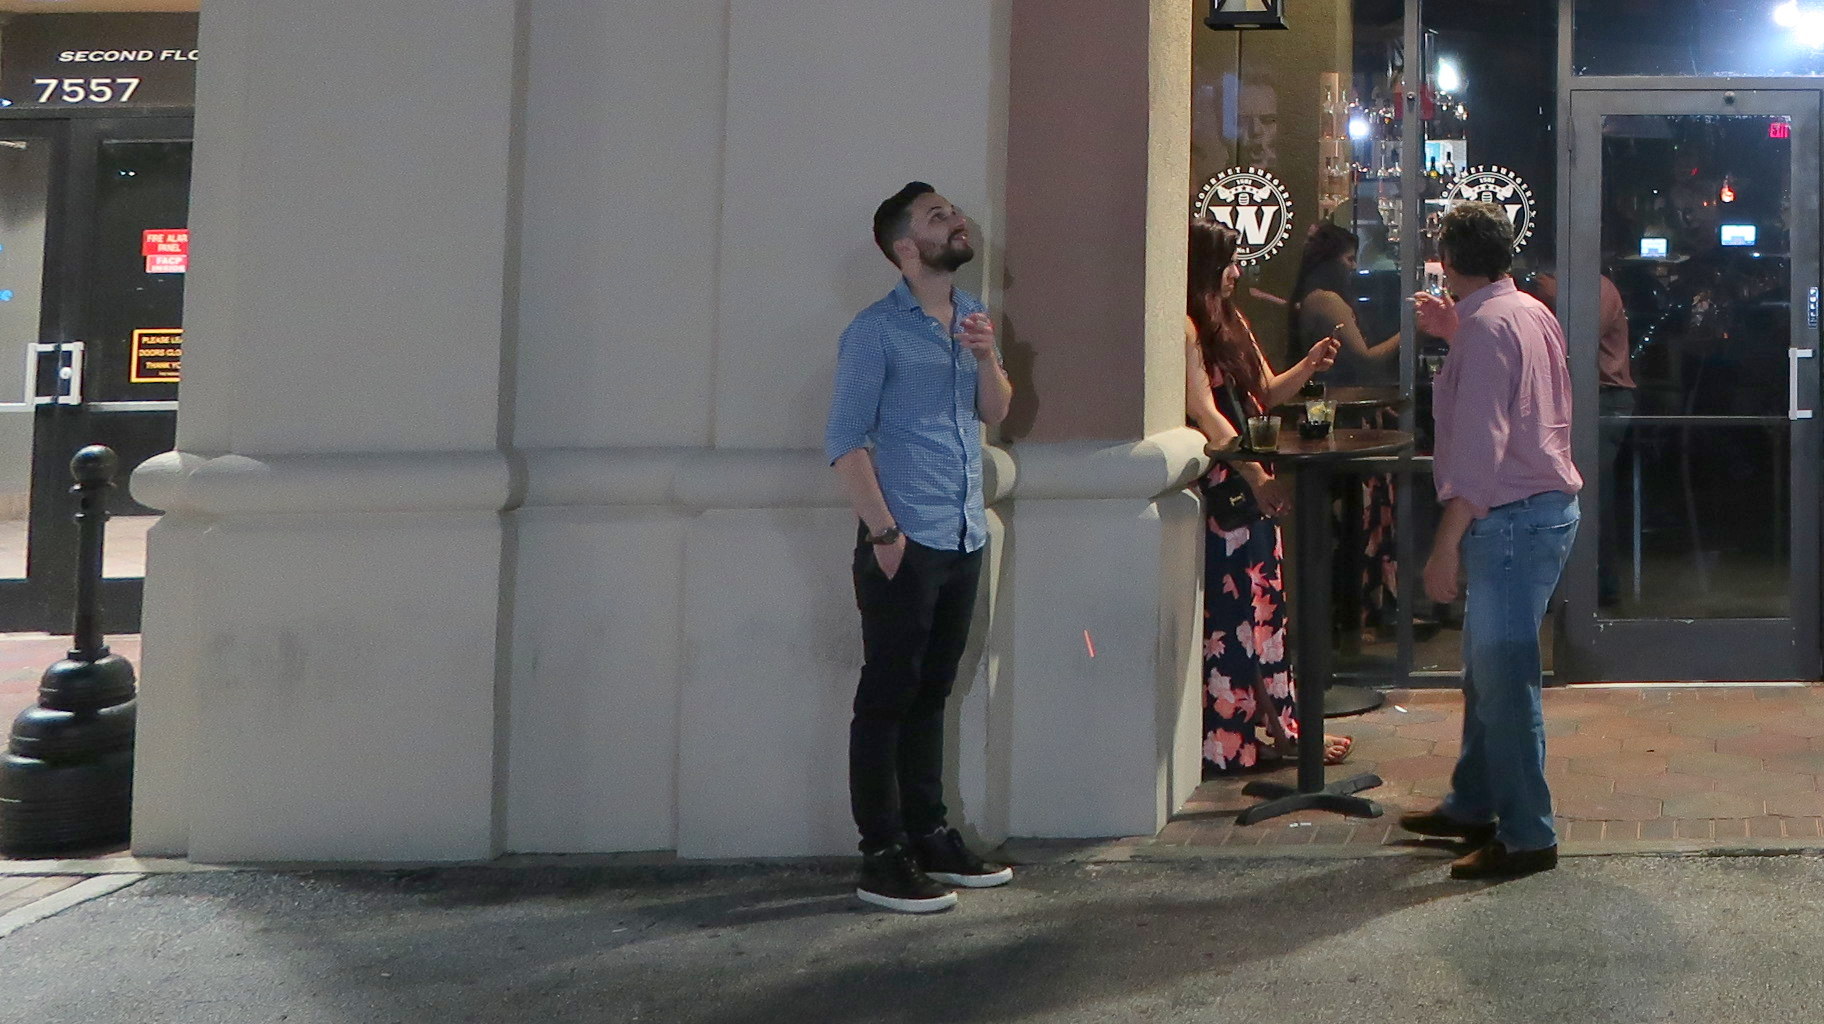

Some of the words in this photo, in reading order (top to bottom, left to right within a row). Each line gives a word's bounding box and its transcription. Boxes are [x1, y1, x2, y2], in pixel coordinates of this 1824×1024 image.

[59, 50, 154, 62] SECOND
[34, 78, 141, 103] 7557
[1441, 165, 1485, 198] OURMET
